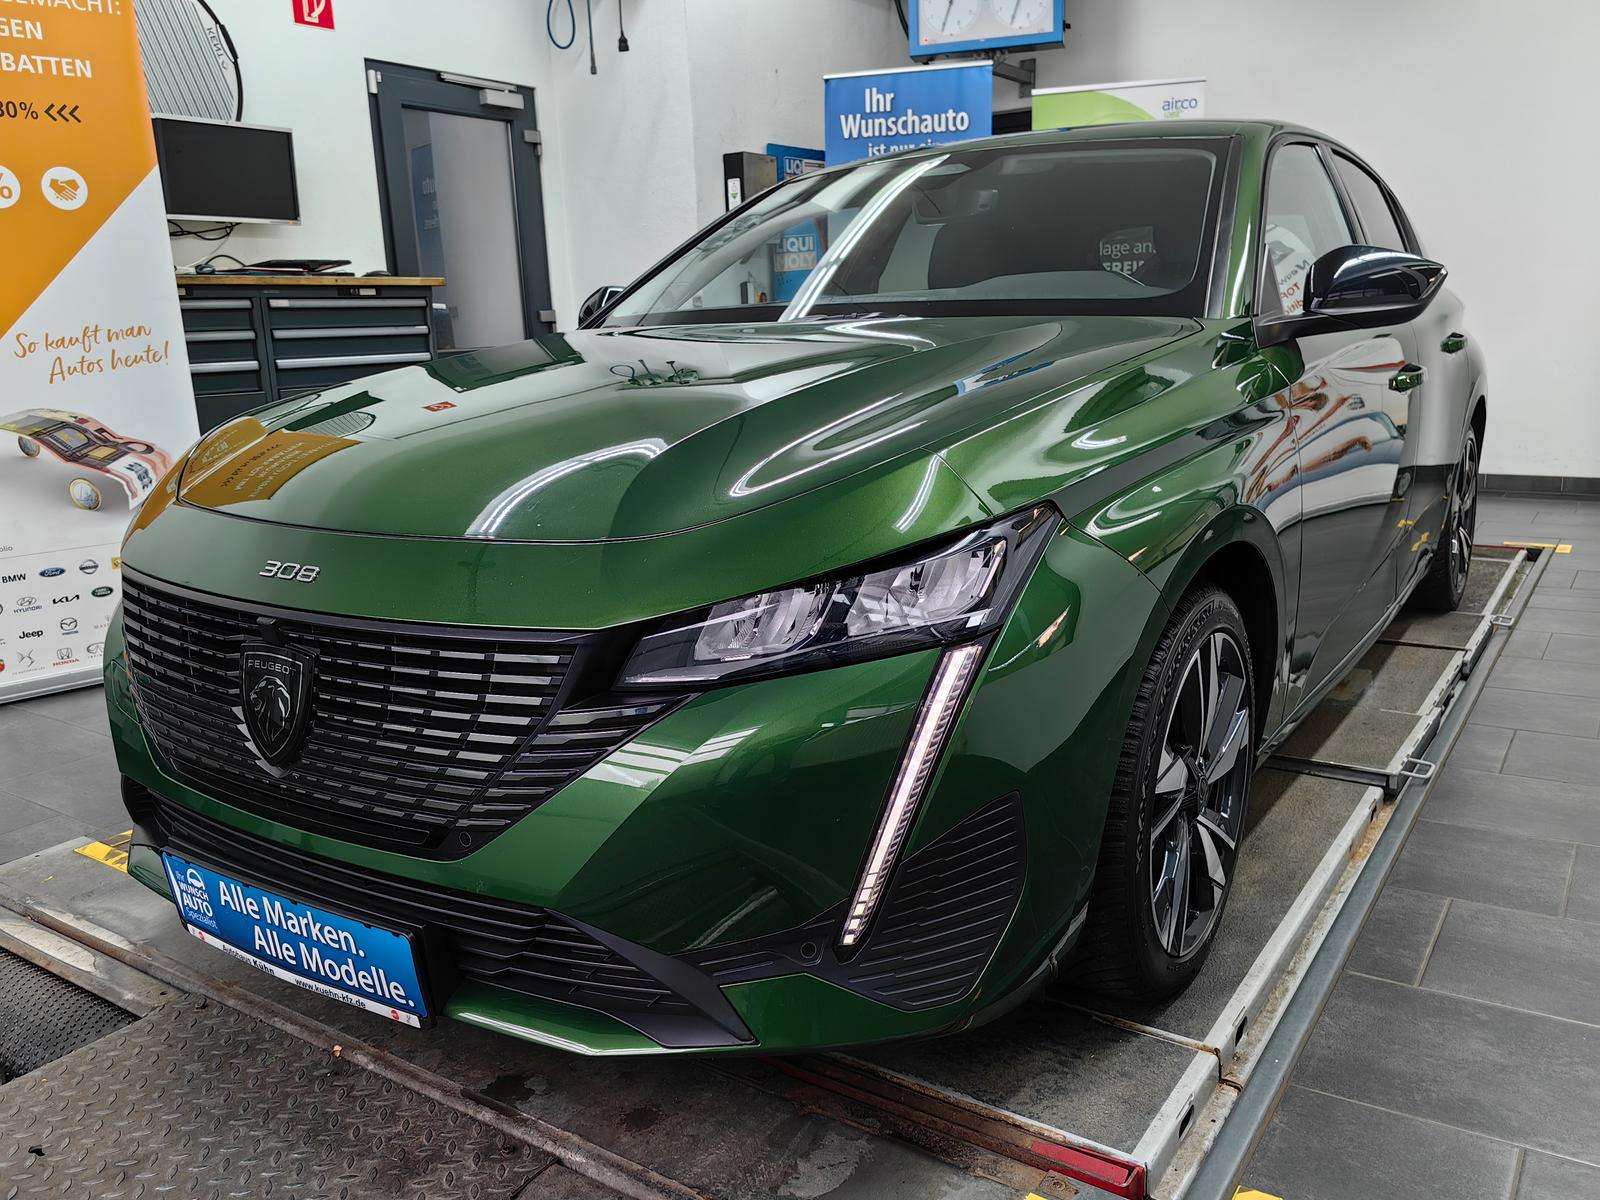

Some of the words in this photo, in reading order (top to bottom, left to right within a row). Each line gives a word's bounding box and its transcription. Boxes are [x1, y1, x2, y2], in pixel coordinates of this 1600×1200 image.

[864, 87, 895, 113] Ihr
[1161, 97, 1198, 111] airco
[839, 108, 970, 139] Wunschauto
[868, 143, 885, 157] ist
[14, 332, 39, 359] So
[45, 324, 101, 353] kauft
[106, 324, 152, 343] man
[49, 356, 104, 385] Autos
[111, 340, 170, 371] heute!
[2, 573, 26, 584] BMW
[259, 560, 320, 583] 308
[19, 630, 44, 639] Jeep
[247, 659, 297, 675] PEUGEOT
[177, 881, 210, 901] WUNSCH
[183, 892, 213, 917] AUTO
[218, 880, 260, 919] Alle
[262, 897, 365, 958] Marken.
[252, 958, 275, 975] Kühn
[254, 925, 297, 966] Alle
[299, 942, 415, 1007] Modelle.
[294, 977, 366, 1010] www.kuehn-kfz.de
